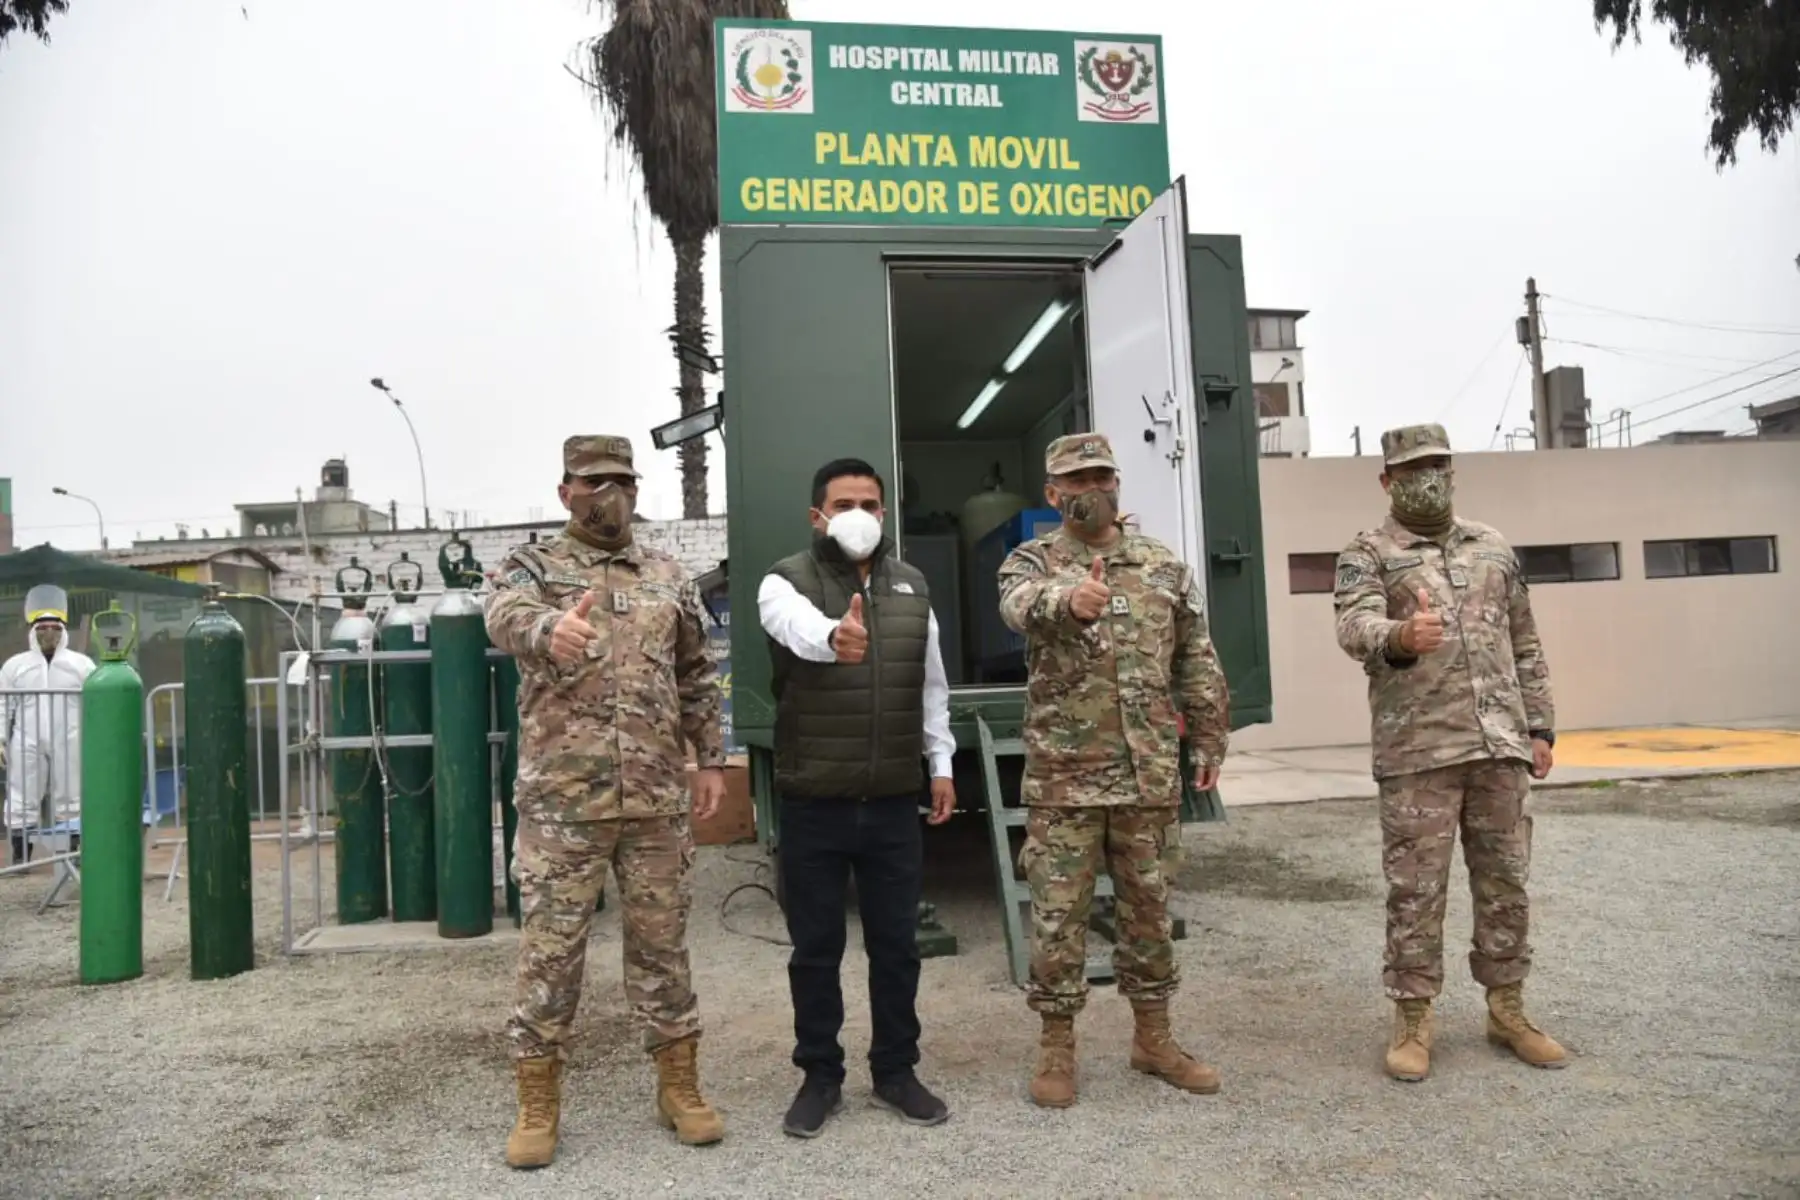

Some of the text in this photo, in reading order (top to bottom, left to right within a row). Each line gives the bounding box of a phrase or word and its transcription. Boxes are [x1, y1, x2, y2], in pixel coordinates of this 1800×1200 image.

[829, 45, 1059, 76] HOSPITAL MILITAR
[891, 81, 1003, 107] CENTRAL
[815, 132, 1080, 170] PLANTA MOVIL
[740, 177, 1152, 217] GENERADOR DE OXIGENO
